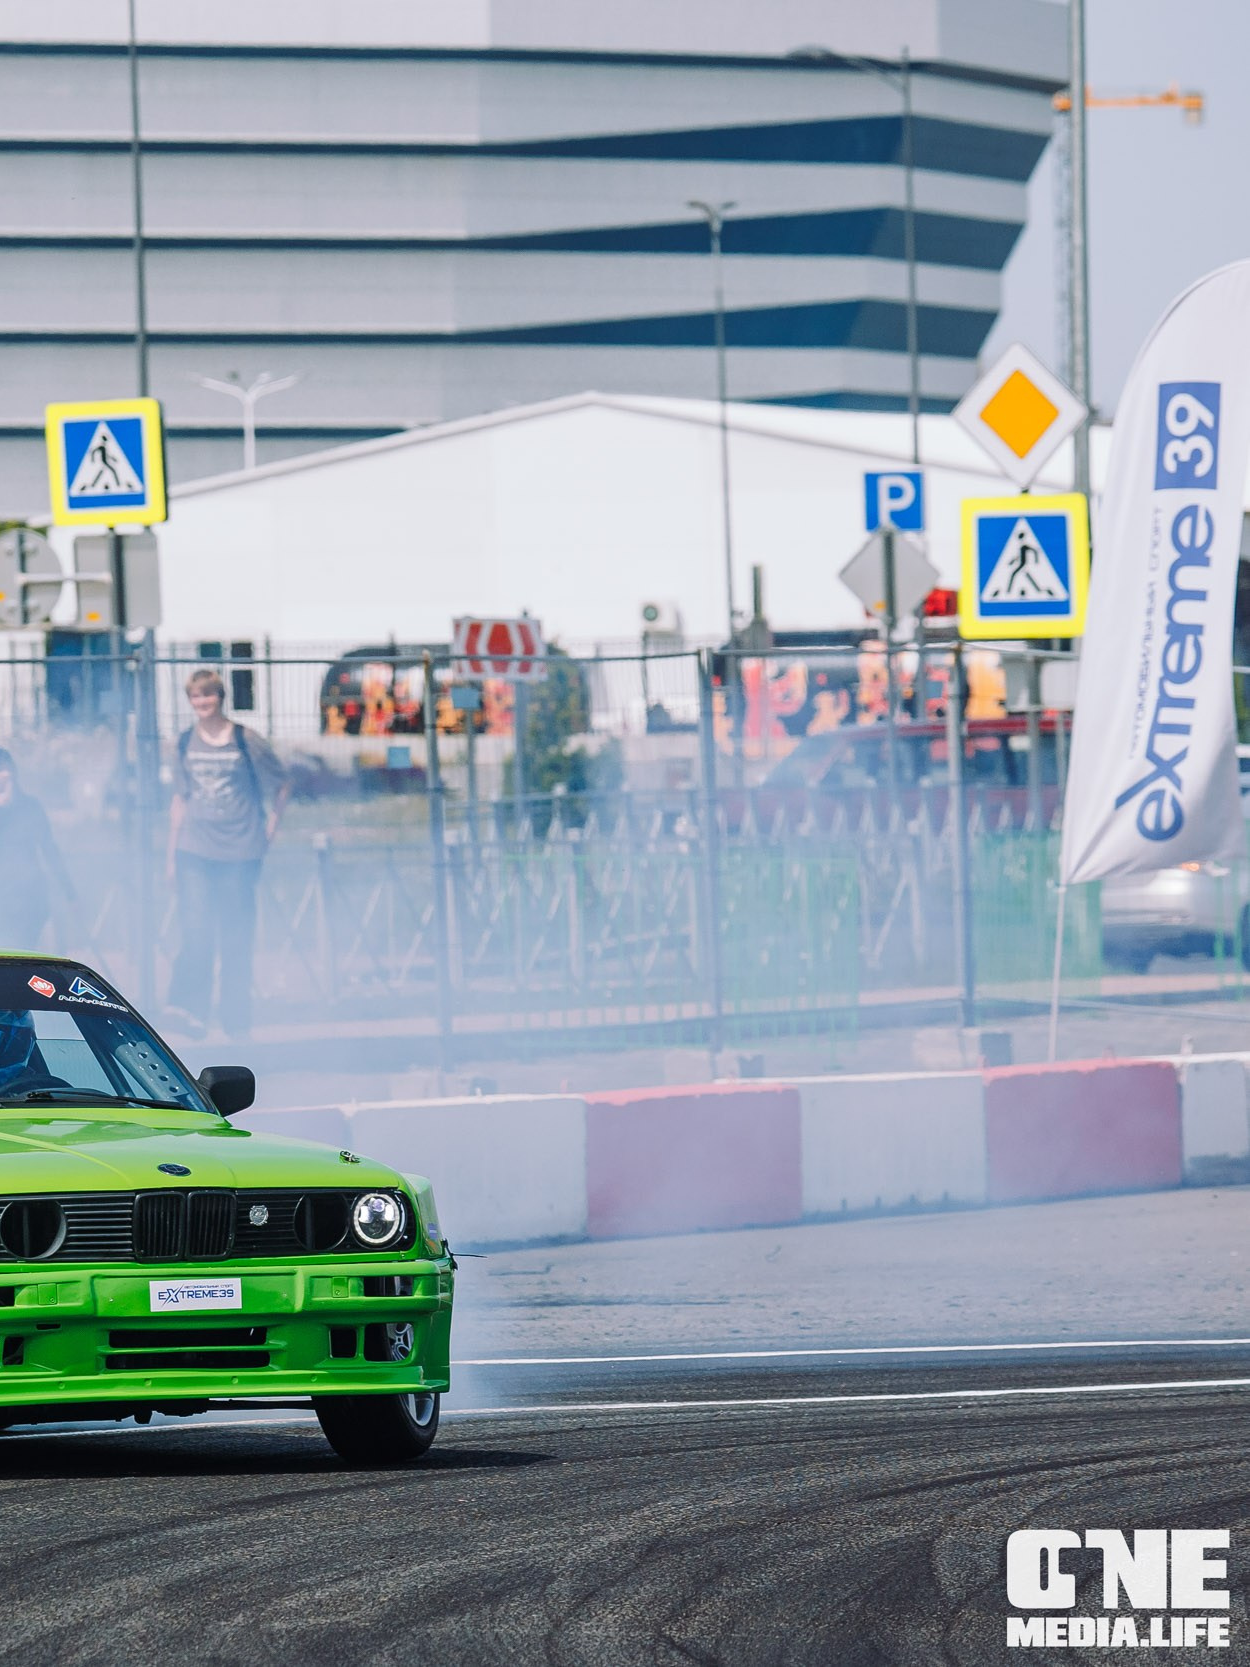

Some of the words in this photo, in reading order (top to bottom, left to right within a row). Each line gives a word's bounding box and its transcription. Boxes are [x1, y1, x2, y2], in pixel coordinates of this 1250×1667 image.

[1163, 391, 1216, 479] 39
[877, 475, 916, 526] P
[158, 1284, 234, 1308] EXTREME39
